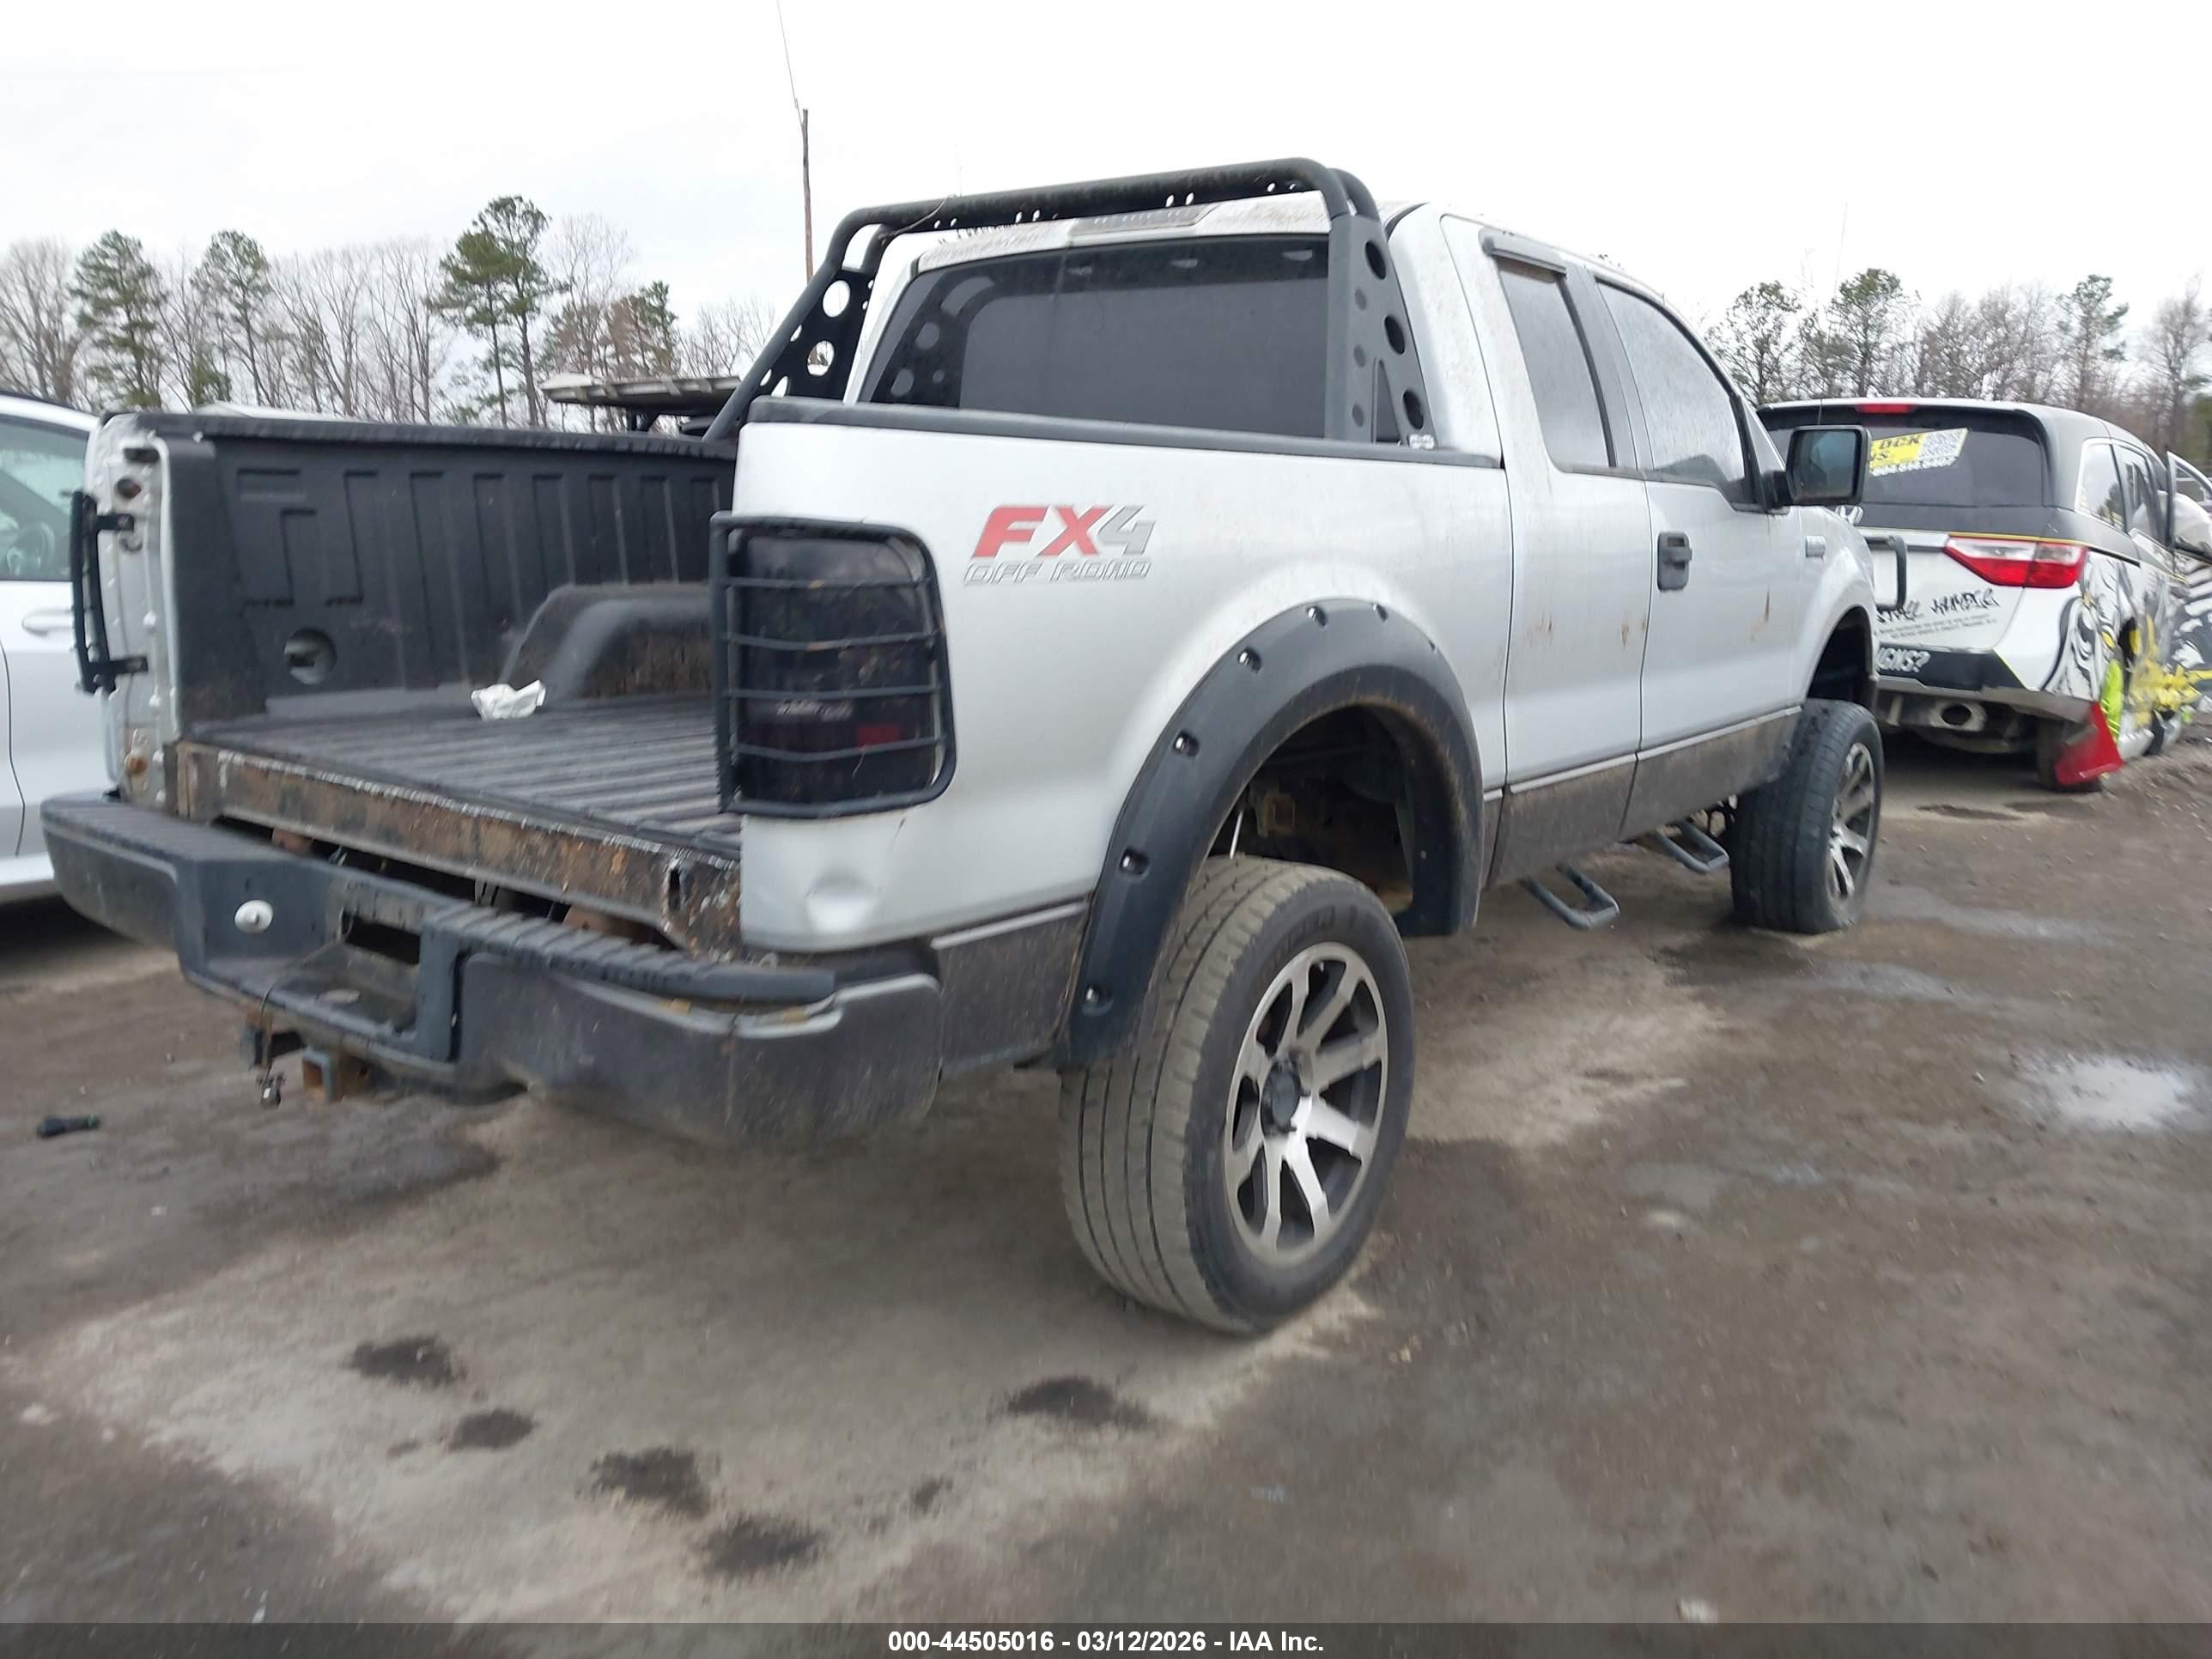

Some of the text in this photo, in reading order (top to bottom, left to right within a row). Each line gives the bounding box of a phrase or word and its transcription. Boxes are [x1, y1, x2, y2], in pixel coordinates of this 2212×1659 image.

[971, 505, 1157, 558] FX4
[963, 557, 1152, 586] OFF ROAD
